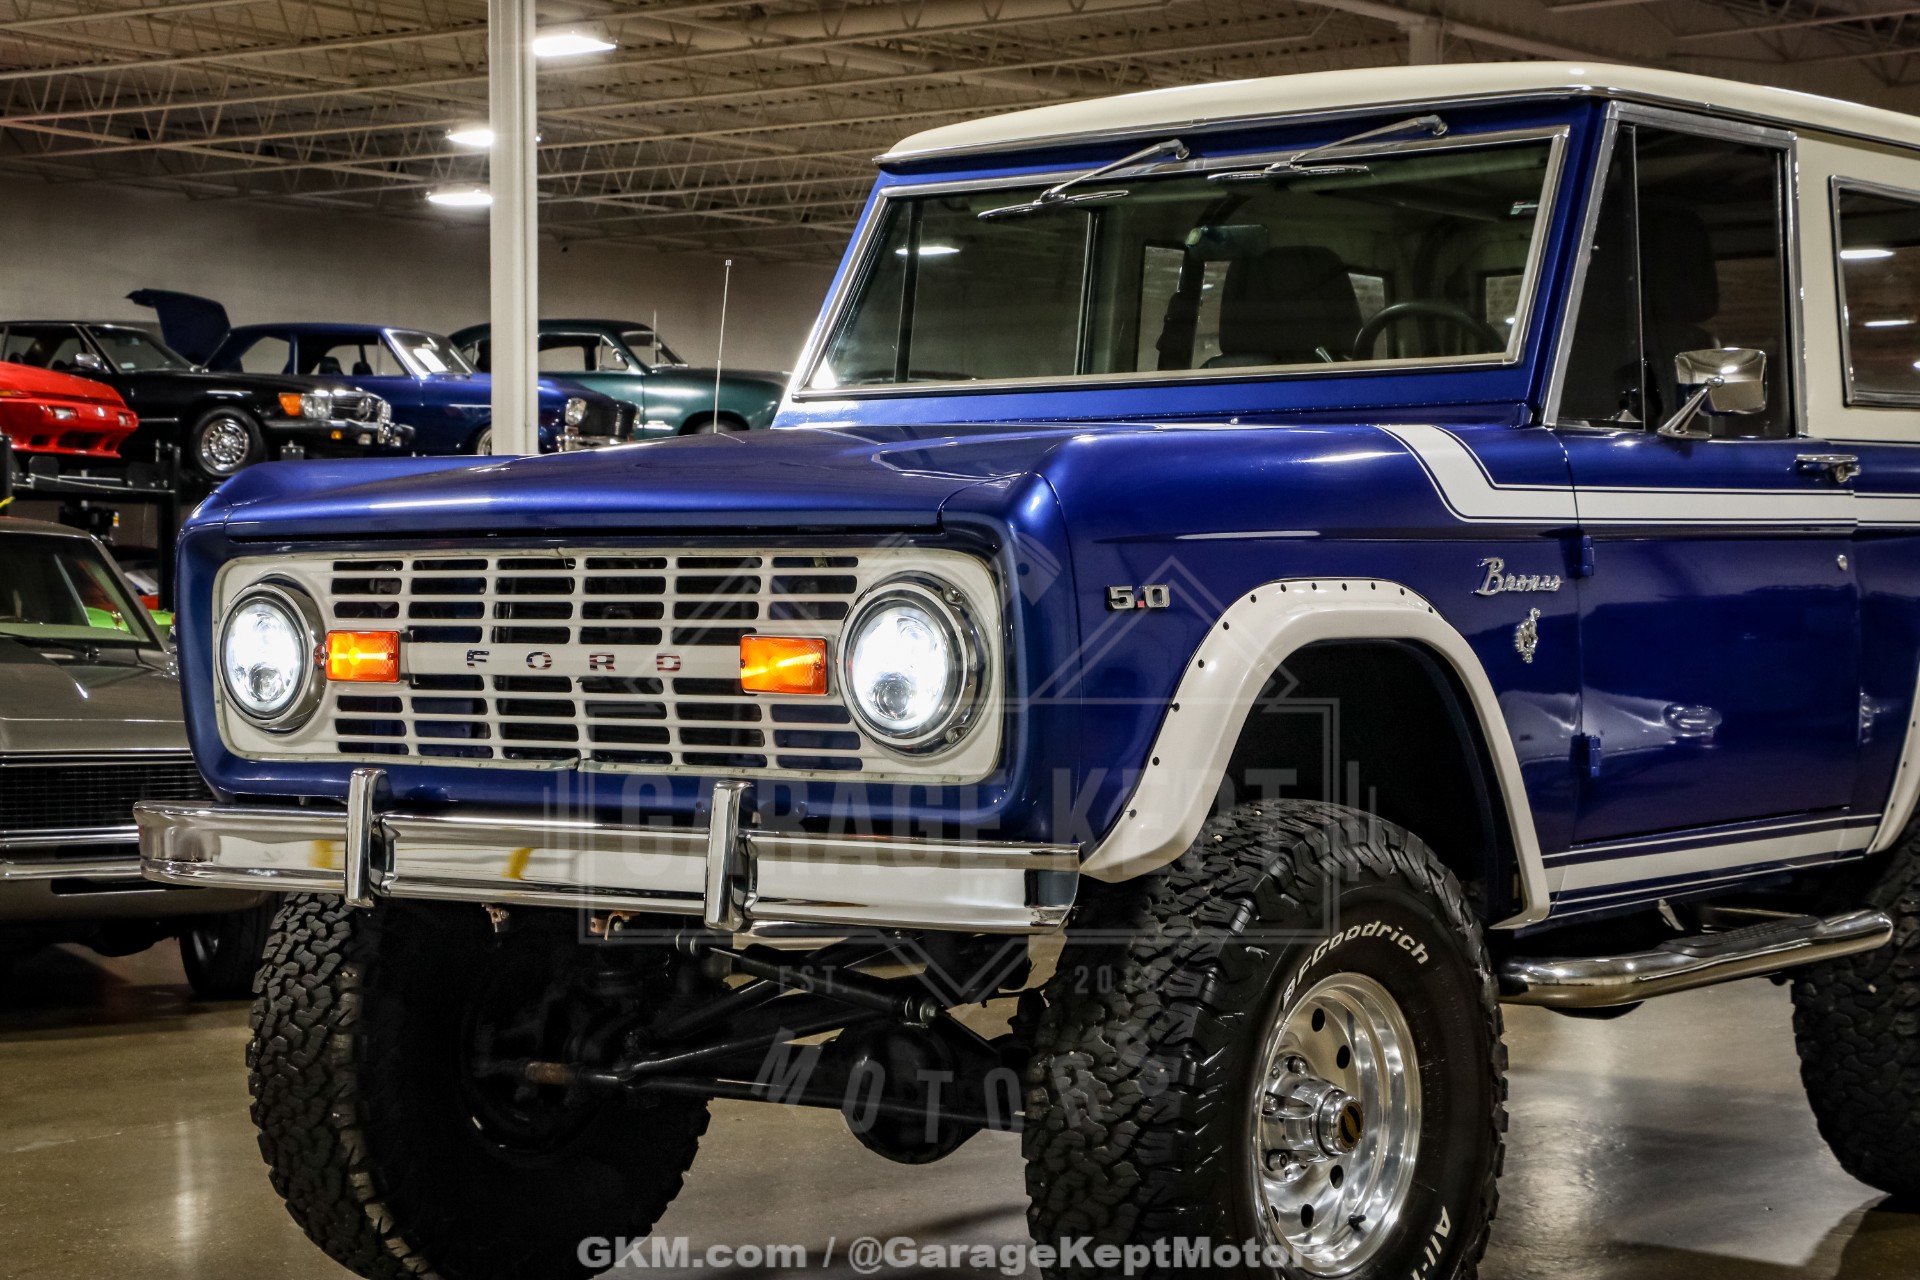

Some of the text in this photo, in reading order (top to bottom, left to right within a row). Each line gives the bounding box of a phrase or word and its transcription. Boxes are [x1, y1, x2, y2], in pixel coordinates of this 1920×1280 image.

[1470, 556, 1564, 596] Bronco
[1105, 584, 1171, 610] 5.0
[466, 649, 682, 672] FORD
[1283, 920, 1430, 1011] BFGoodrich
